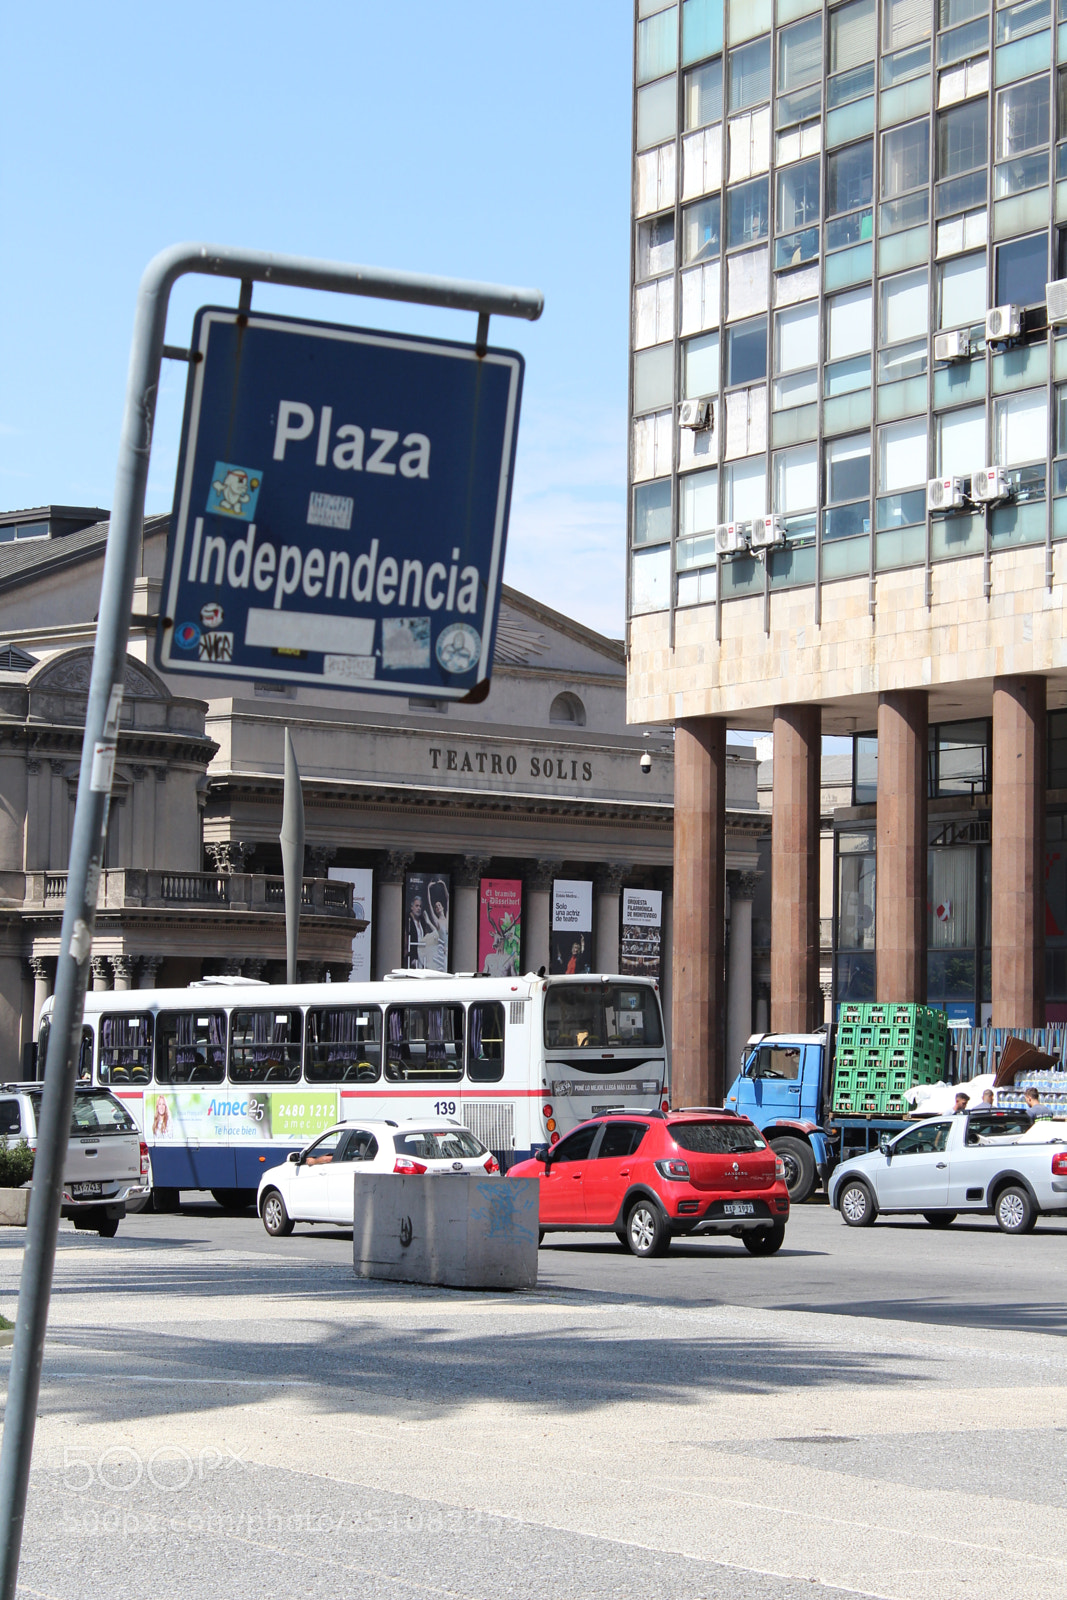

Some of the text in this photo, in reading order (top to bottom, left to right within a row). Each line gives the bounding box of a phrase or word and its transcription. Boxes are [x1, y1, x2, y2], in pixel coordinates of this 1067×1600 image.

[273, 399, 431, 479] Plaza
[187, 517, 480, 614] Independencia
[429, 748, 593, 781] TEATRO SOLIS
[555, 902, 568, 910] Solo
[566, 909, 580, 917] actriz
[207, 1098, 248, 1116] Amec
[248, 1098, 265, 1121] 25
[278, 1104, 335, 1117] 2480 1212
[433, 1101, 456, 1116] 139
[214, 1126, 257, 1135] Te hace bien
[284, 1120, 329, 1129] amec.uy
